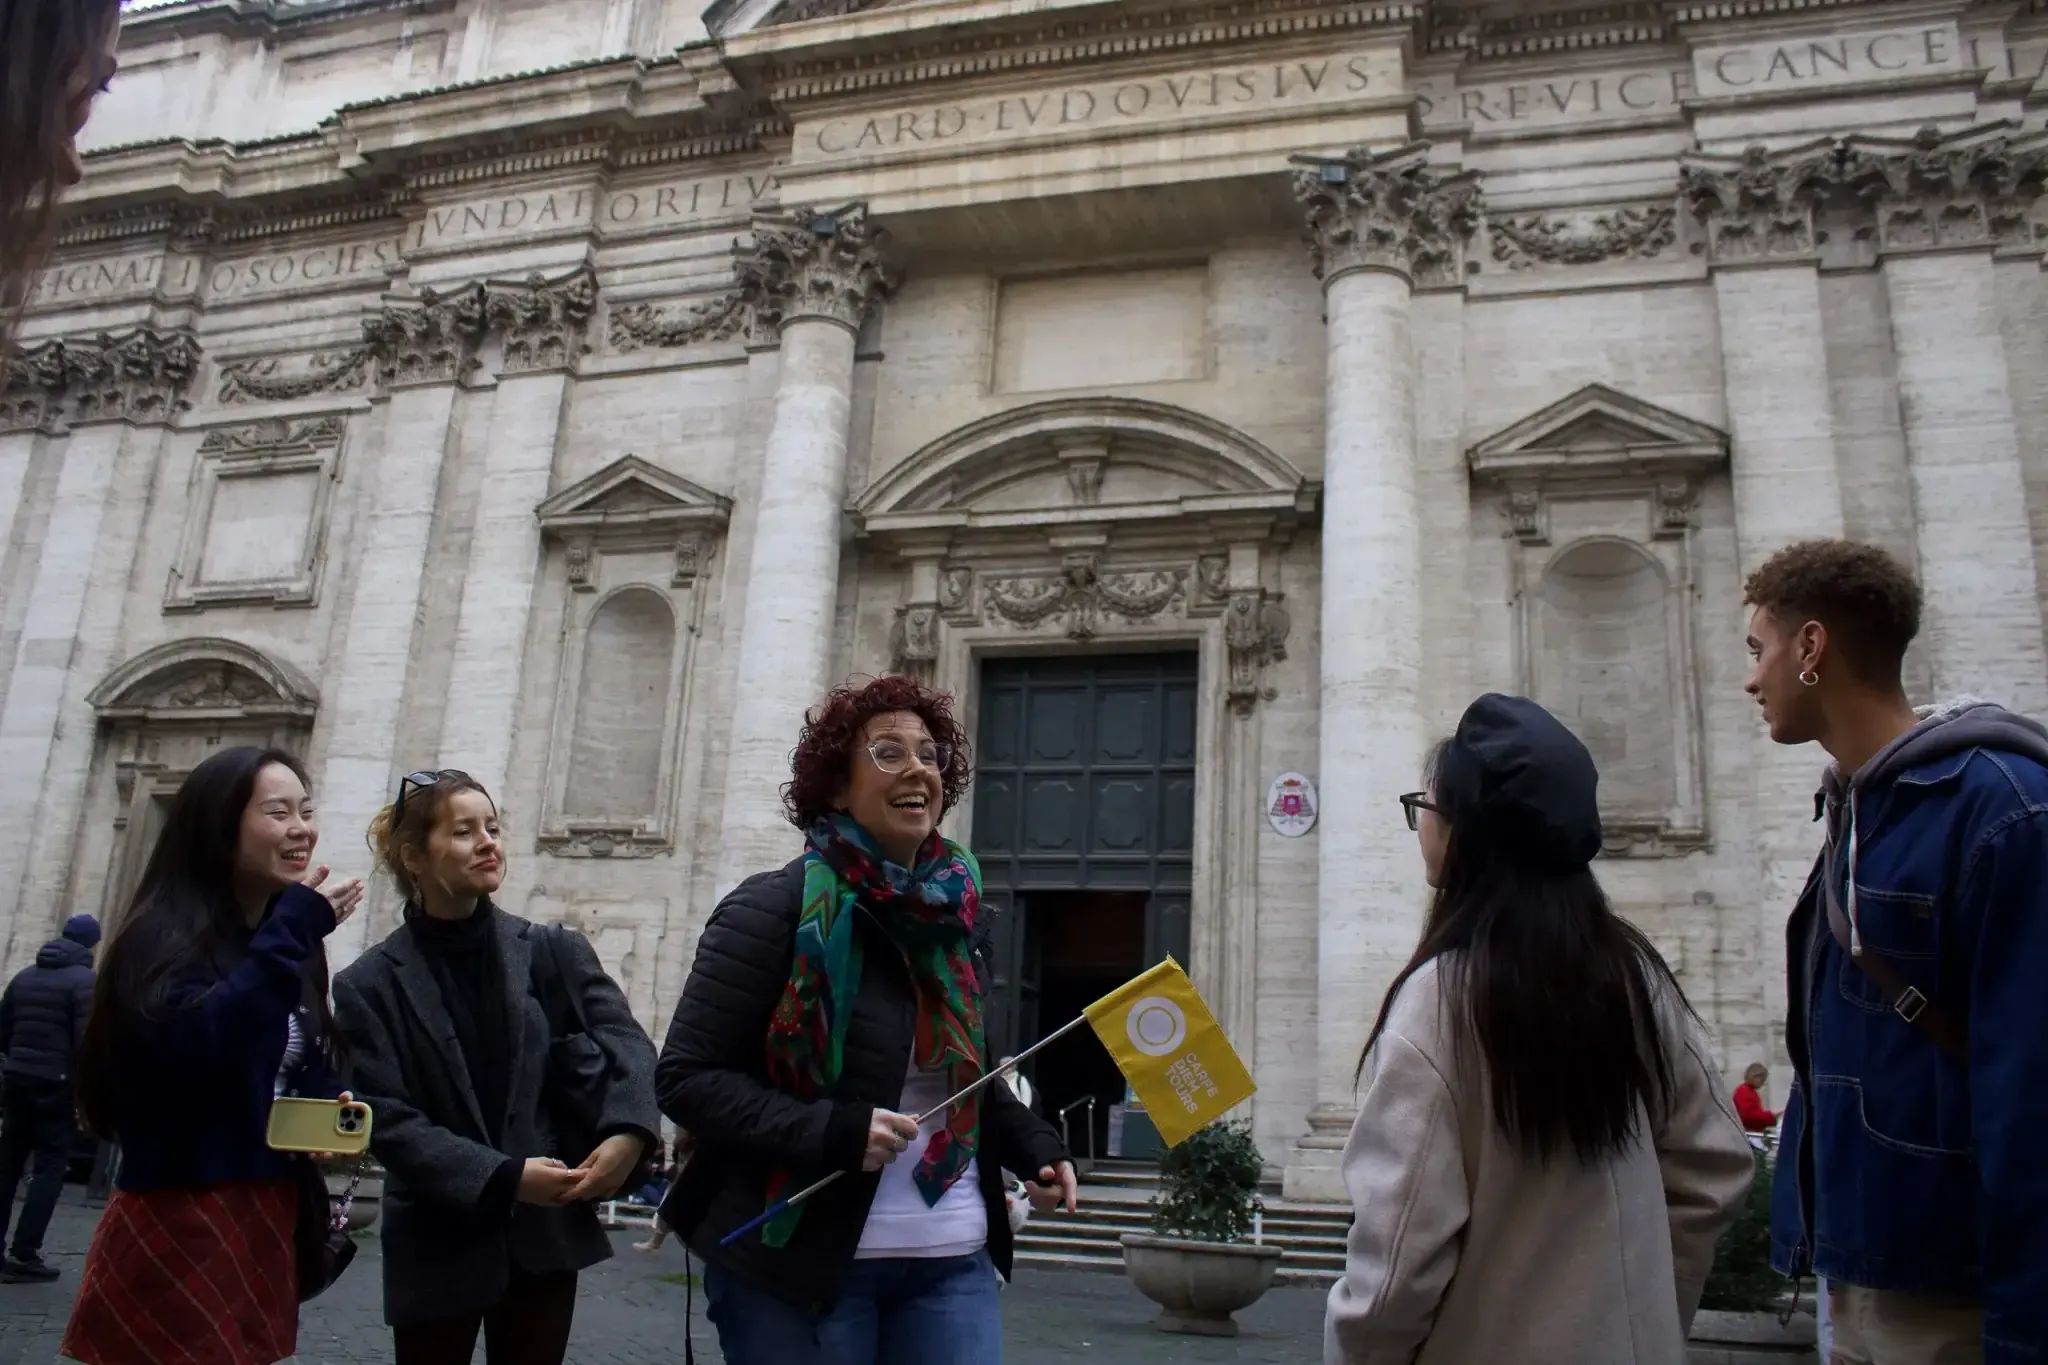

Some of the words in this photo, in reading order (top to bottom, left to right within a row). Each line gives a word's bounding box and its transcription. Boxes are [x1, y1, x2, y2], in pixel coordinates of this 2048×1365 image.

[1165, 1065, 1198, 1114] TOURS
[1174, 1058, 1200, 1093] DIEM
[1187, 1053, 1219, 1097] CARPE
